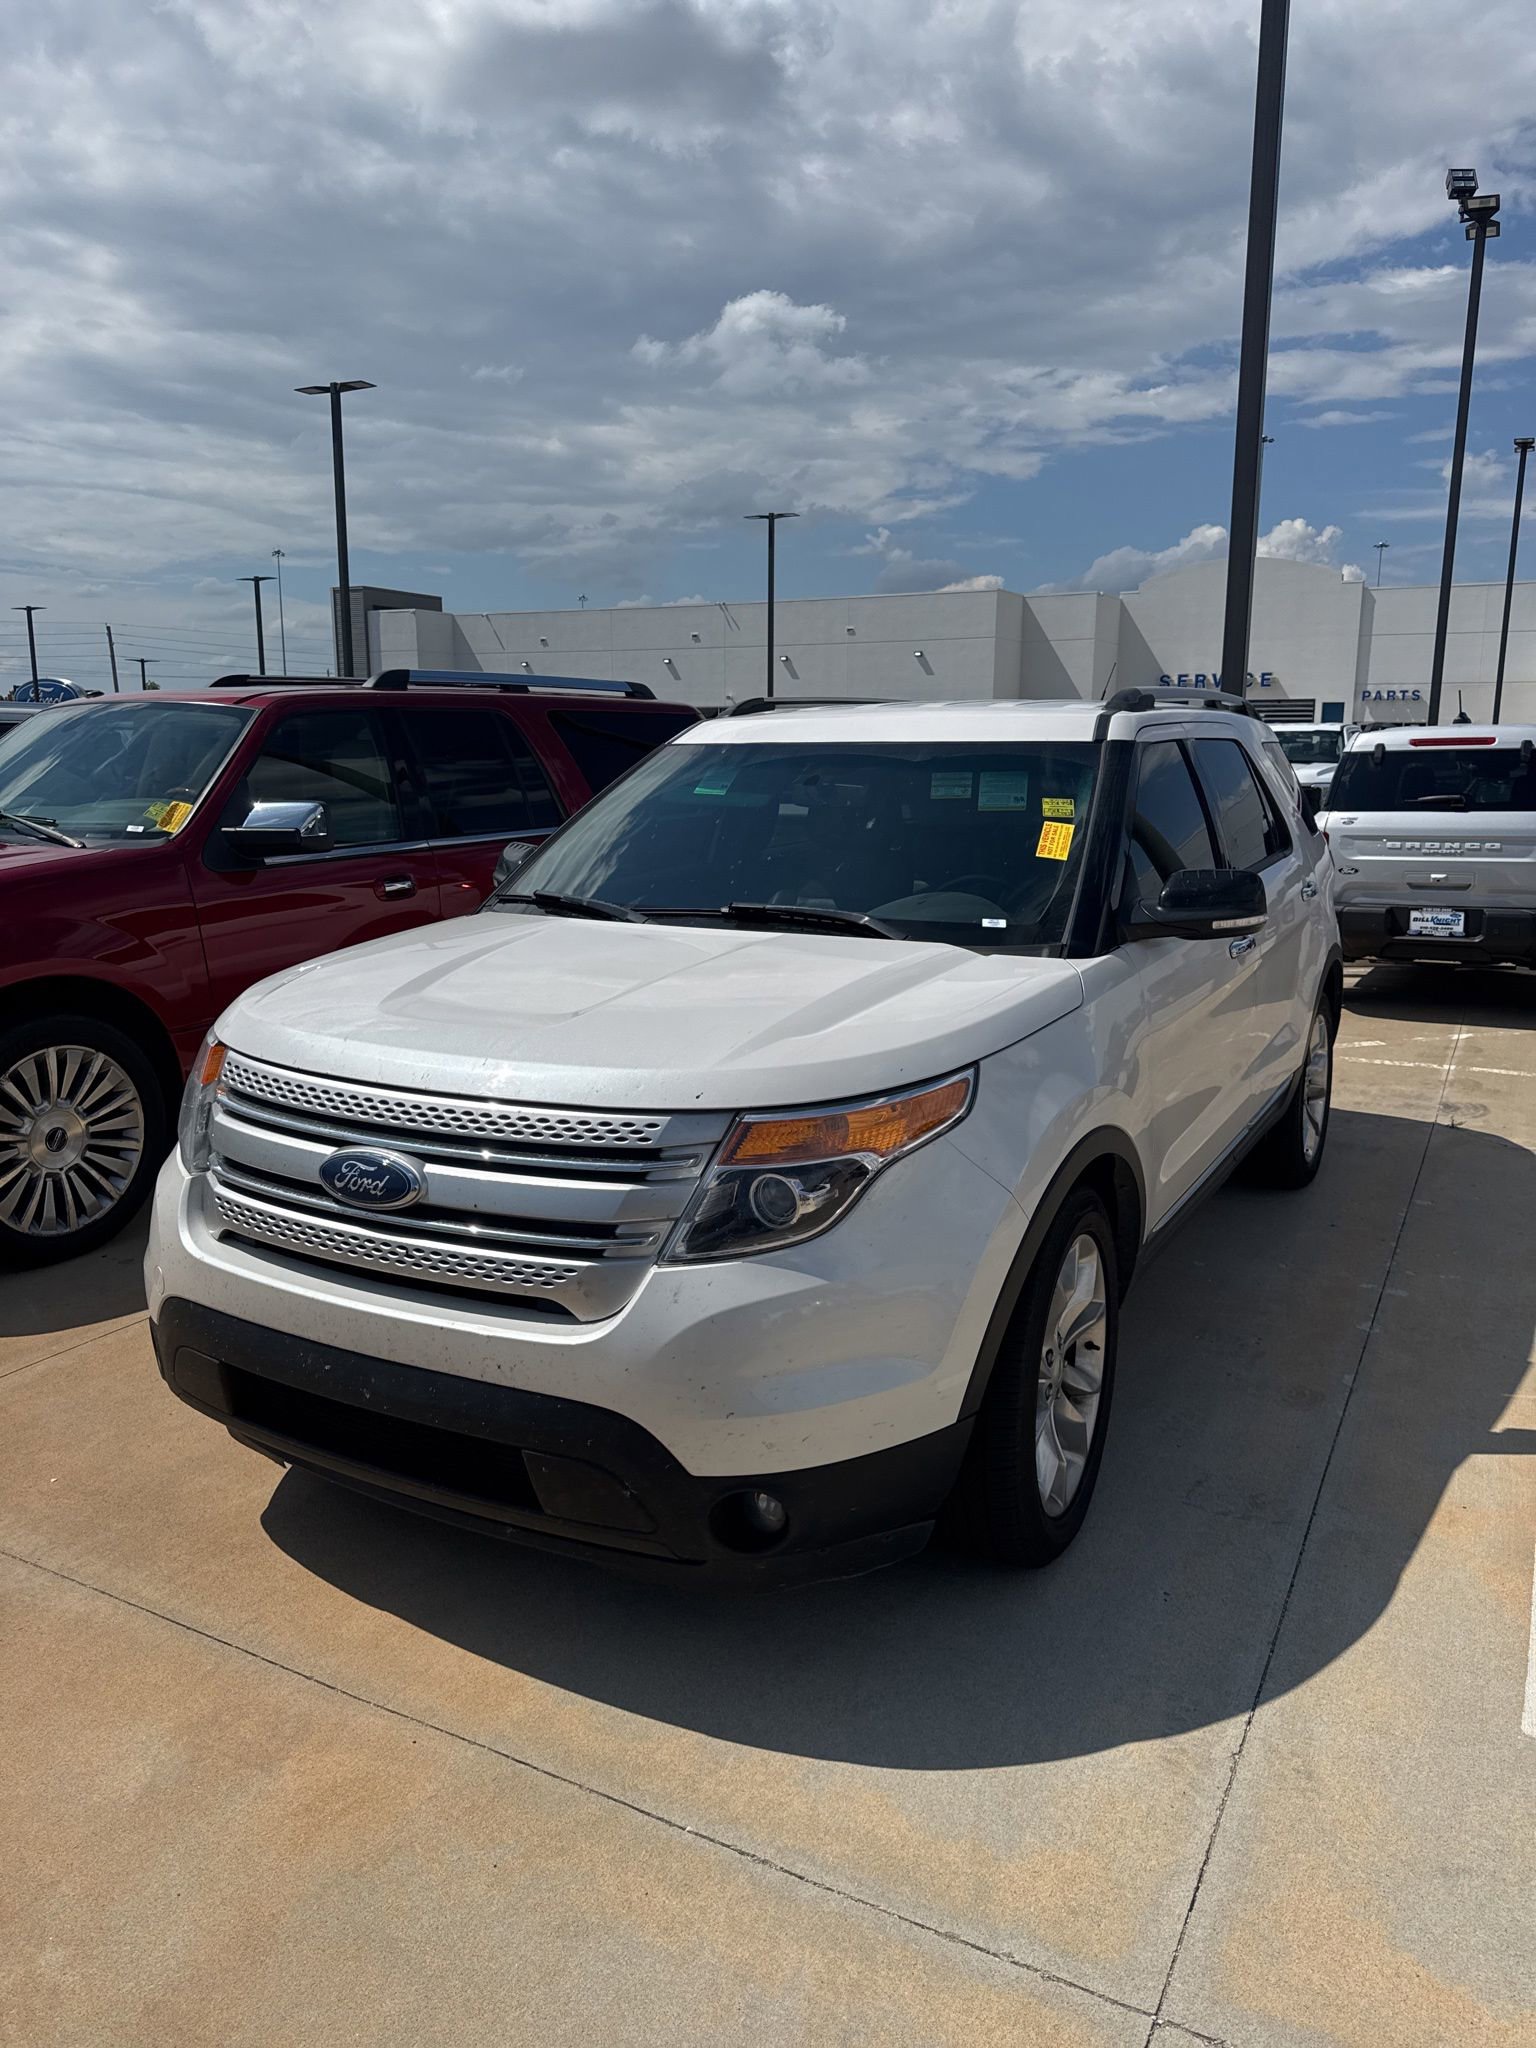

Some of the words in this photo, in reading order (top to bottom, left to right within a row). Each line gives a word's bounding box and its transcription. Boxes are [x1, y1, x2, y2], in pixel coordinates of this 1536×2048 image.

[1159, 672, 1273, 688] SERVCE
[1361, 690, 1420, 701] PARTS
[1386, 841, 1501, 850] BRONCO
[334, 1160, 390, 1196] Ford
